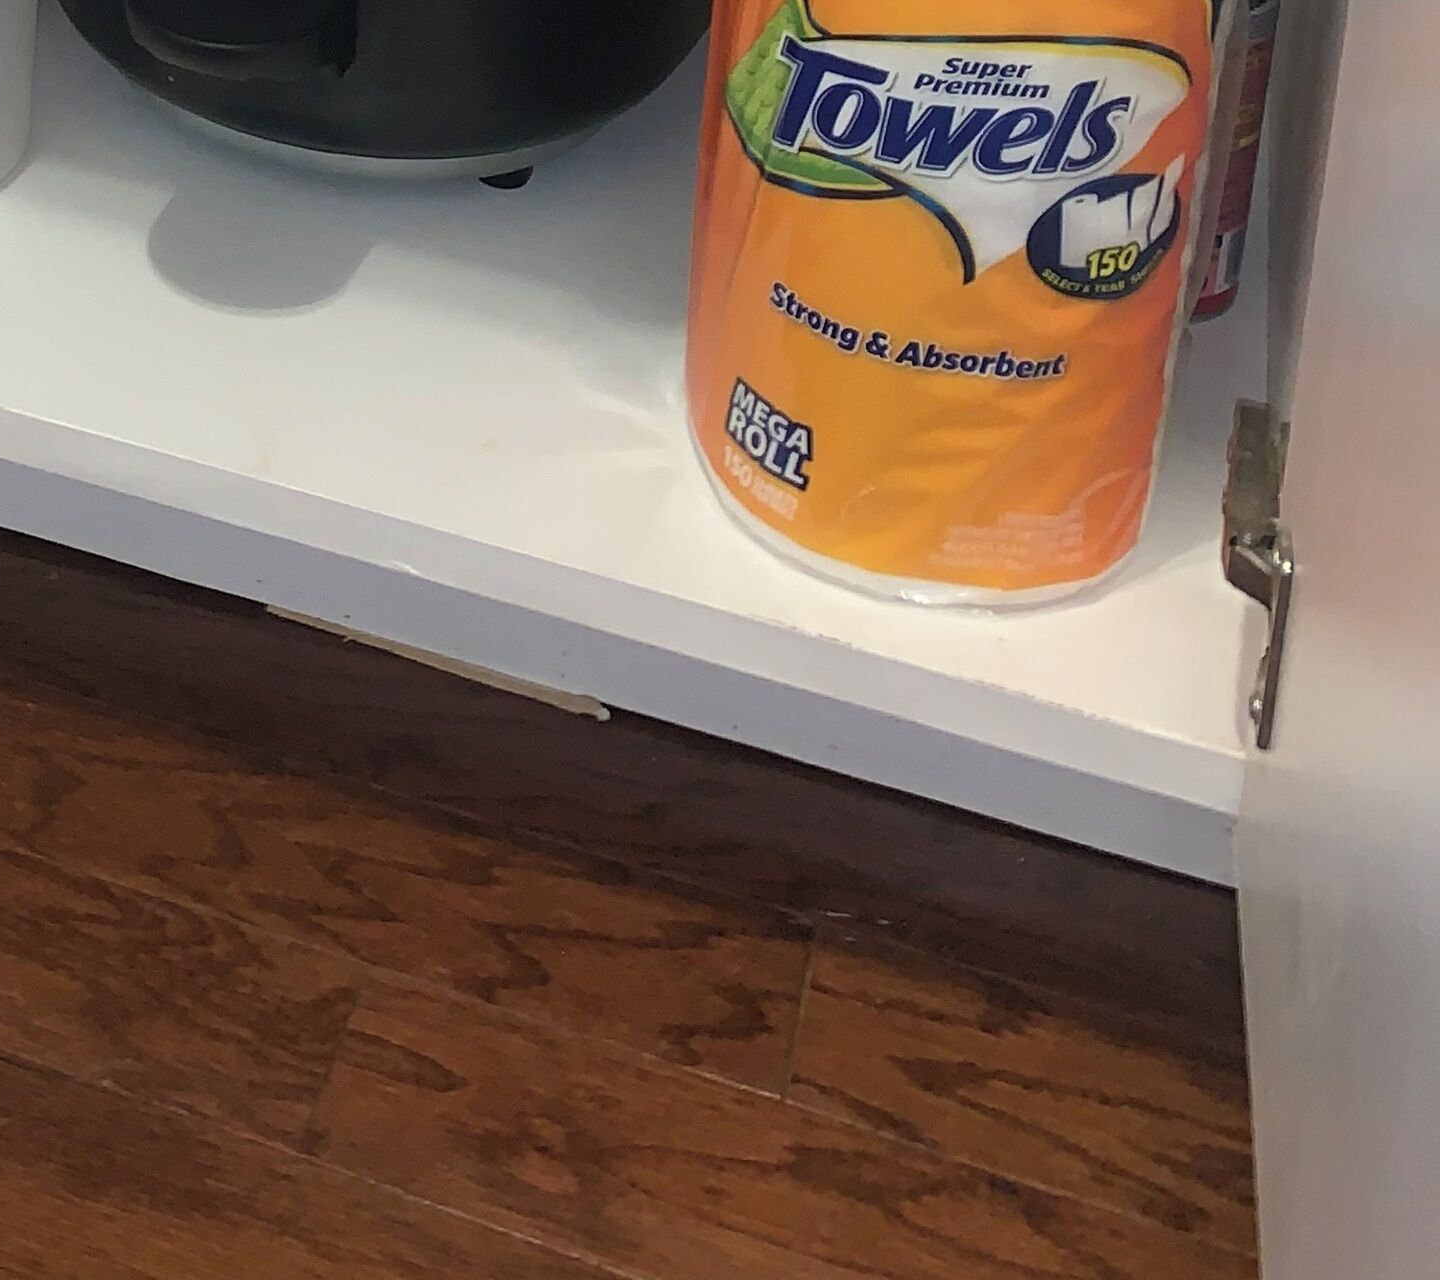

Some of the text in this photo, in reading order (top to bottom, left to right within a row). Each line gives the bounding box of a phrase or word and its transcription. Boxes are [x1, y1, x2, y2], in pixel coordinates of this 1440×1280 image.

[913, 73, 1050, 99] Premium
[941, 56, 1033, 79] Super
[771, 36, 1133, 176] Towels
[1087, 242, 1140, 280] 150
[770, 281, 1066, 379] Strong & Absorbent
[727, 405, 806, 486] ROLL
[732, 382, 810, 456] MEGA
